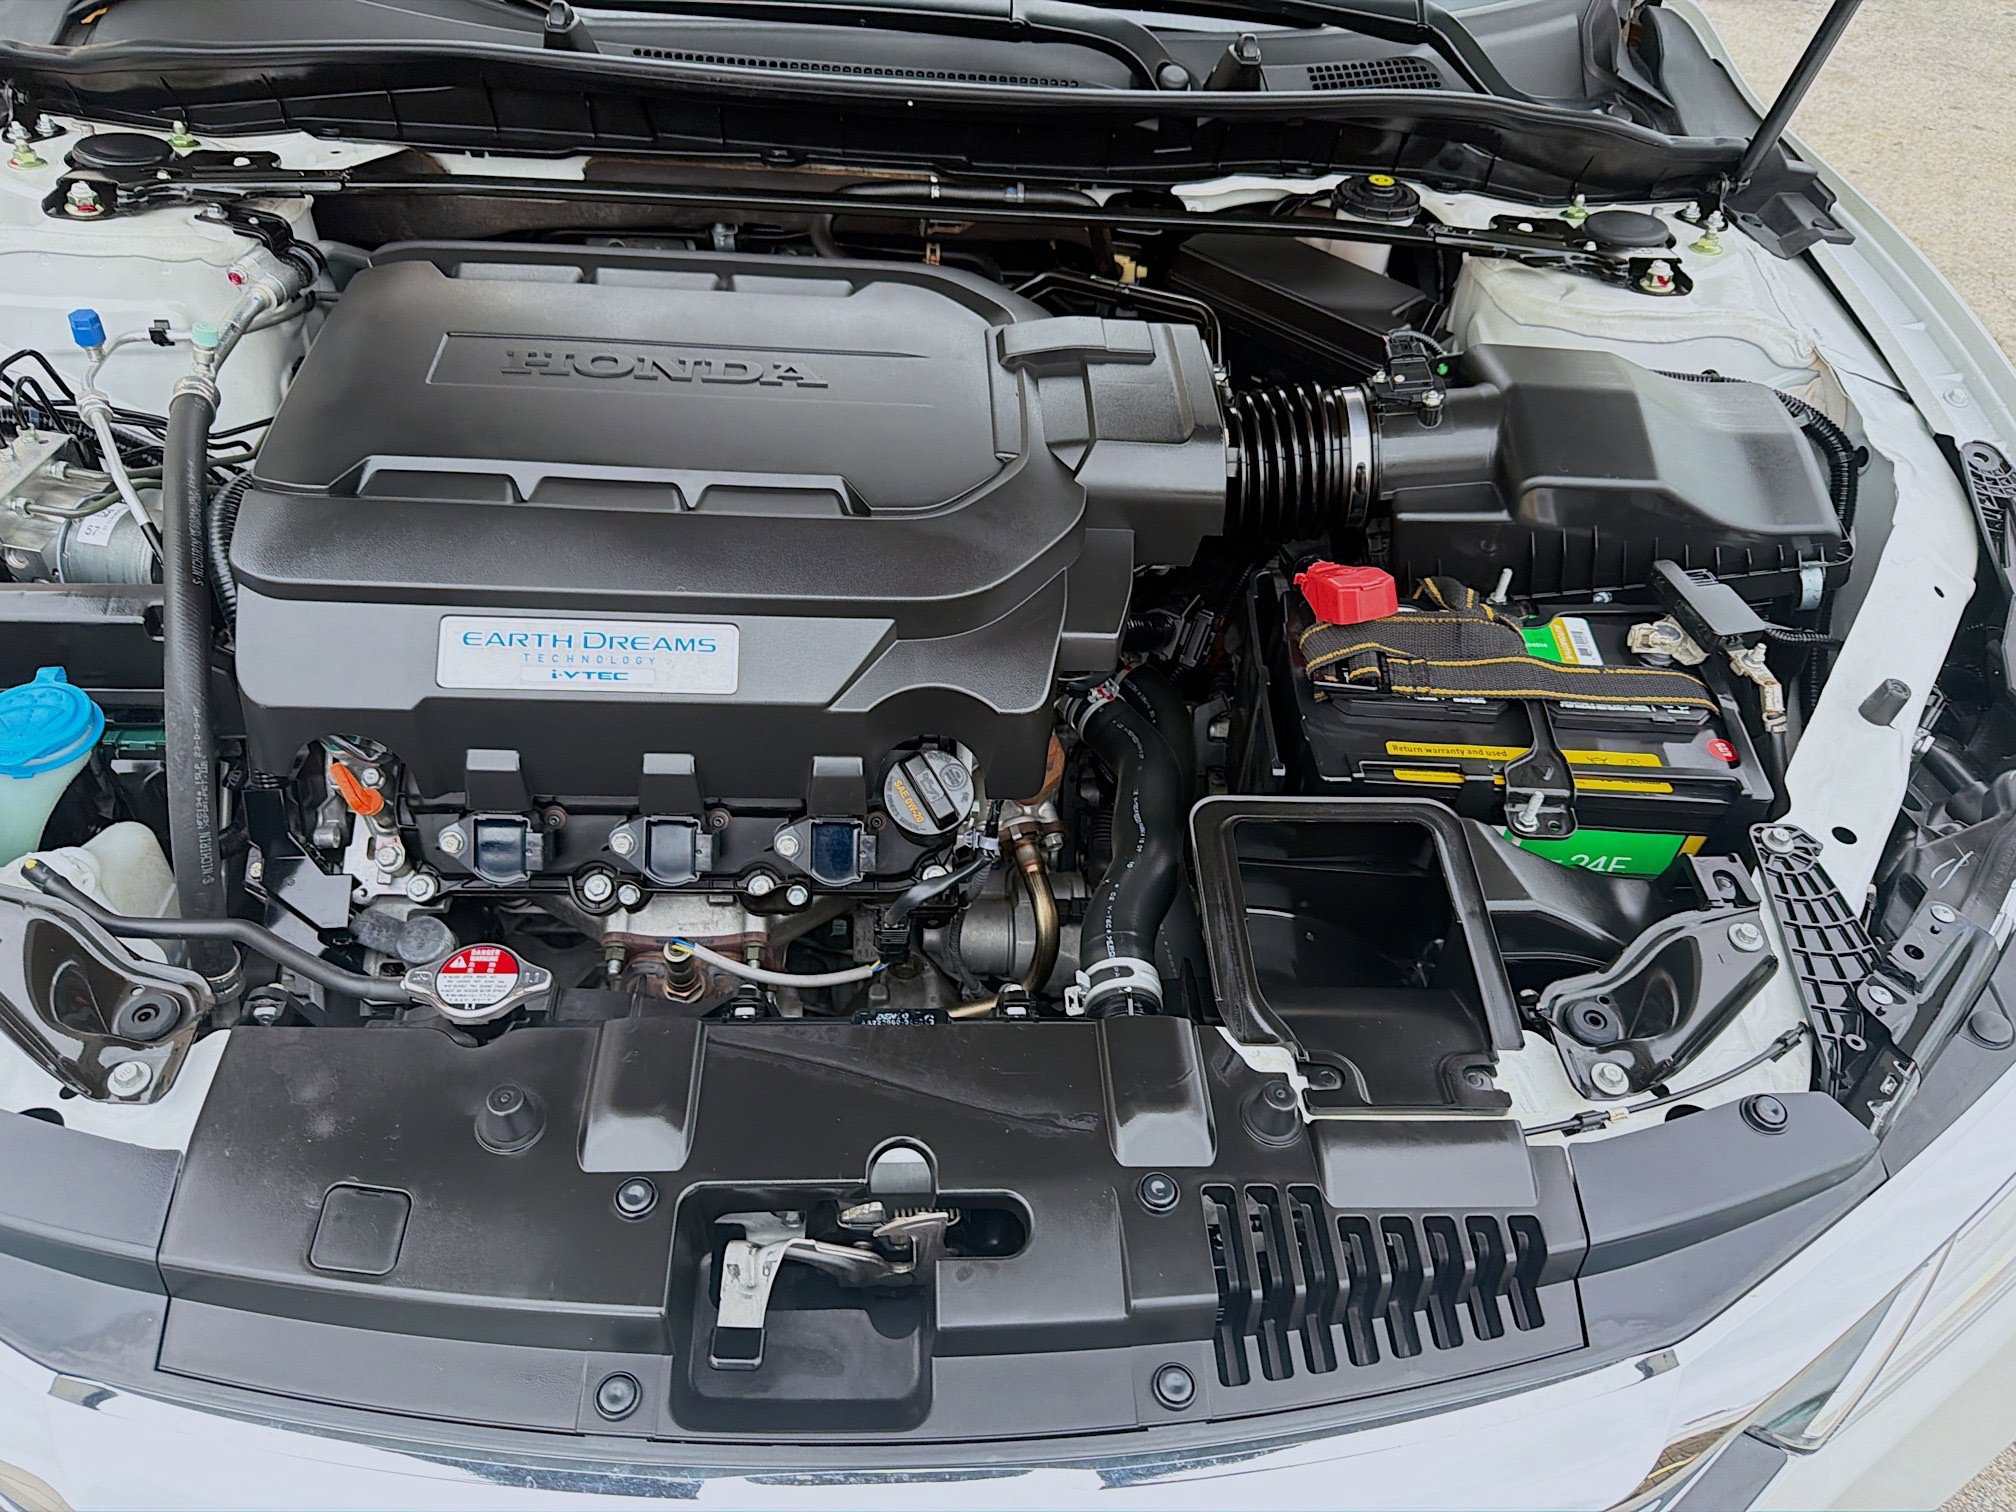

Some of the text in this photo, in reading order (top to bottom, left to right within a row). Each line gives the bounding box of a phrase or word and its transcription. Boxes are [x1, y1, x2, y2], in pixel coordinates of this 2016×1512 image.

[501, 351, 829, 388] HONDA
[463, 631, 716, 653] EARTH DREAMS
[522, 653, 656, 665] TECHNOLOGY
[551, 669, 629, 681] i-VTEC
[1392, 744, 1423, 753] Return
[1425, 748, 1465, 756] warranty
[1467, 748, 1486, 757] and
[894, 780, 910, 798] SAE
[904, 797, 925, 823] 0W-20
